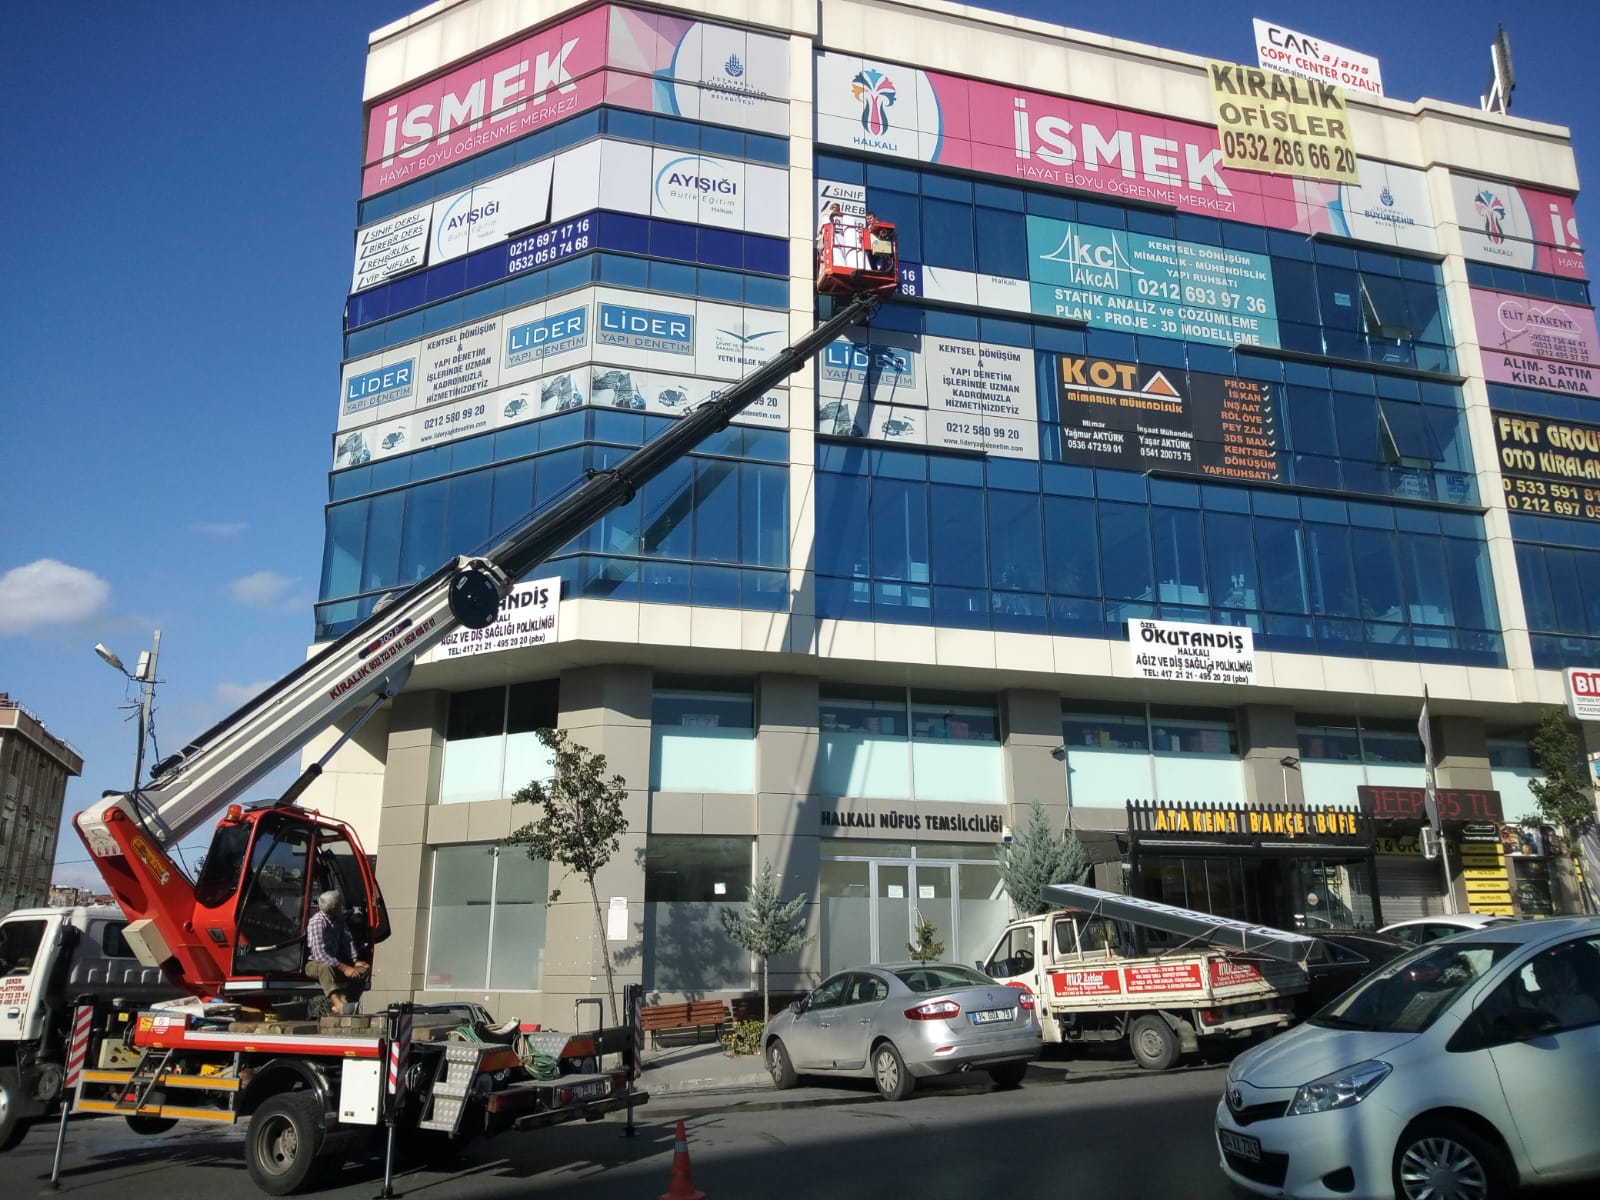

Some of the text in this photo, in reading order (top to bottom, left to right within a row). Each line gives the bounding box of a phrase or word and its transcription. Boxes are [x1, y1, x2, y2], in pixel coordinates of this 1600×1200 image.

[1260, 45, 1338, 80] COPY CENTER
[1322, 53, 1369, 75] ajans
[1211, 63, 1343, 110] KİRALIK
[381, 37, 580, 168] İSMEK
[1219, 103, 1347, 140] OFİSLER
[853, 136, 898, 151] HALKALI
[1013, 97, 1233, 197] İSMEK
[1223, 131, 1355, 173] 0532 286 66 20
[379, 161, 417, 186] HAYAT
[418, 150, 452, 171] BOYU
[668, 172, 737, 196] AYIŞIĞI
[832, 187, 865, 200] SINIF
[1016, 164, 1236, 213] HAYAT BOYU MERKEZİ
[701, 195, 736, 208] Eğitim
[370, 214, 420, 239] SINIF DERSİ
[447, 201, 500, 231] AYIŞIĞI
[400, 224, 423, 239] DERS
[509, 219, 590, 257] 0212 697 17 16
[509, 235, 589, 273] 0532 058 74 68
[1133, 250, 1187, 267] MİMARLIK
[1148, 240, 1196, 256] KENTSEL
[901, 269, 916, 282] 16
[1166, 268, 1238, 288] YAPI RUHSATI
[1137, 278, 1267, 314] 0212 693 97 36
[1055, 288, 1259, 331] STATİK ANALİZ ve ÇÖZÜMLEME
[1502, 308, 1574, 330] ELİT ATAKENT
[511, 316, 582, 350] LİDER
[604, 311, 687, 338] LİDER
[1055, 304, 1260, 345] PLAN PROJE 3D MODELLEME
[426, 322, 497, 351] KENTSEL DÖNÜŞÜM
[600, 332, 690, 352] YAPI DENETİM
[433, 347, 487, 370] YAPI DENETİM
[508, 336, 585, 364] YAPI DENETİM
[717, 354, 736, 363] YETKİ
[938, 344, 1021, 362] KENTSEL DÖNÜŞÜM
[426, 356, 492, 383] İŞLERİNDE UZMAN
[950, 366, 1012, 381] YAPI DENETİM
[1061, 356, 1137, 391] KOT
[1547, 364, 1592, 380] SATIM
[349, 368, 409, 399] LİDER
[432, 370, 483, 391] KADROMUZLA
[942, 377, 1020, 394] İŞLERİNDE UZMAN
[1224, 379, 1258, 391] PROJE
[1512, 370, 1589, 393] KİRALAMA
[346, 386, 412, 412] YAPI DENETİM
[426, 379, 489, 404] HİZMETİNİZDEYİZ
[766, 397, 778, 407] 20
[952, 388, 1012, 403] KADROMUZLA
[1228, 389, 1262, 402] İSKAN
[945, 398, 1020, 415] HİZMETİNİZDEYİZ
[1223, 400, 1261, 414] İNŞAAT
[424, 405, 485, 430] 0212 580 20
[1082, 419, 1106, 428] Mimar
[946, 422, 1020, 440] 0212 580 99 20
[1063, 427, 1124, 443] Yağmur AKTÜRK
[1223, 434, 1268, 448] 3DS MAX
[1498, 416, 1600, 453] FRT GROU
[943, 438, 1024, 452] www.lideryapidenetim.com
[1067, 440, 1086, 450] 0536
[1138, 435, 1191, 450] Yaşar AKTÜRK
[1140, 447, 1159, 458] 0541
[1224, 445, 1271, 458] KENTSEL
[1224, 455, 1277, 471] DÖNÜŞÜM
[1502, 447, 1536, 472] OTO
[1516, 479, 1579, 500] 533 591
[1508, 494, 1580, 516] 0 212 697
[459, 631, 470, 642] VE
[471, 628, 483, 643] DİŞ
[484, 624, 515, 640] SAĞLIĞI
[1140, 621, 1157, 629] ÖZEL
[448, 647, 462, 656] TEL:
[462, 643, 474, 653] 417
[1141, 628, 1244, 654] OKUTANDİŞ
[1136, 652, 1169, 667] AĞIZ VE
[1177, 647, 1210, 657] HALKALI
[329, 665, 371, 700] KİRALIK
[1143, 668, 1212, 681] TEL: 495
[1465, 793, 1497, 818] TL
[821, 811, 876, 828] HALKALI
[880, 810, 922, 830] NÜFUS
[1156, 807, 1357, 839] ATAKENT BAHÇE BÜFE
